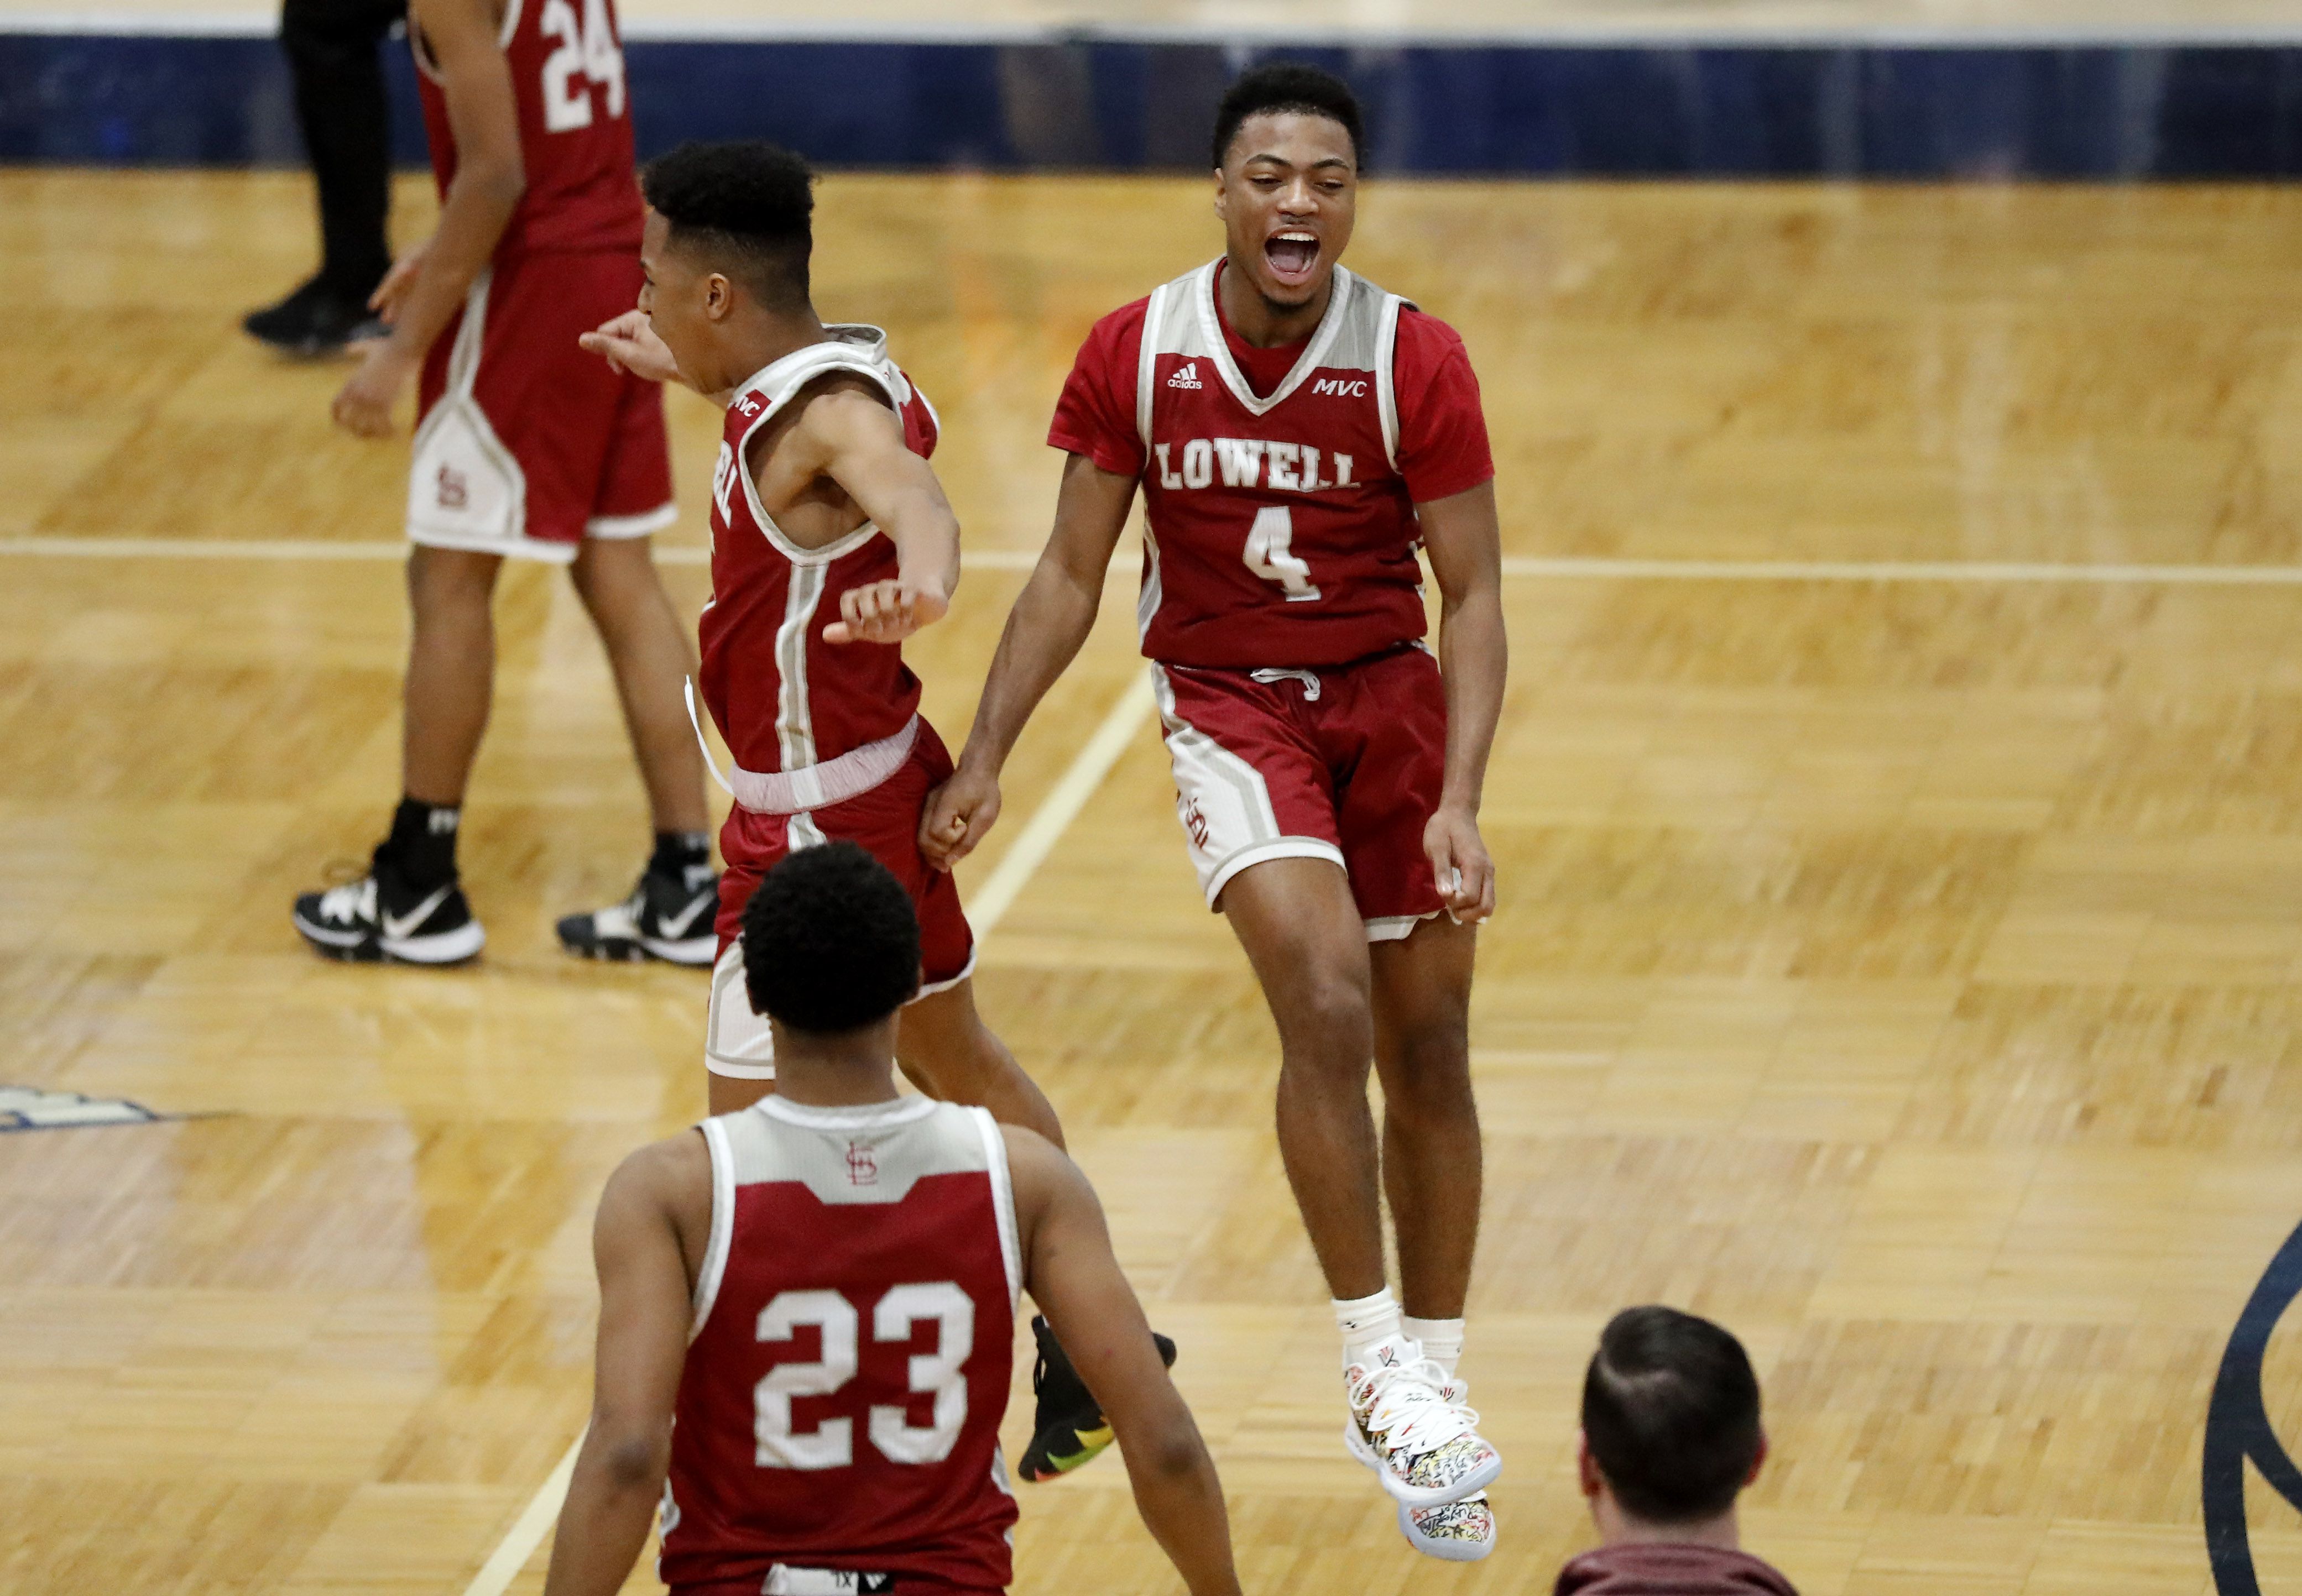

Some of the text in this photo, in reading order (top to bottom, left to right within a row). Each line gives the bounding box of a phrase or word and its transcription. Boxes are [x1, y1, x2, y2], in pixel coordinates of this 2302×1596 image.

[540, 0, 625, 134] 24
[1167, 379, 1202, 389] adidas
[1312, 378, 1367, 397] MVC
[1155, 437, 1361, 492] LOWELL
[1243, 505, 1322, 601] 4
[754, 1281, 974, 1471] 23
